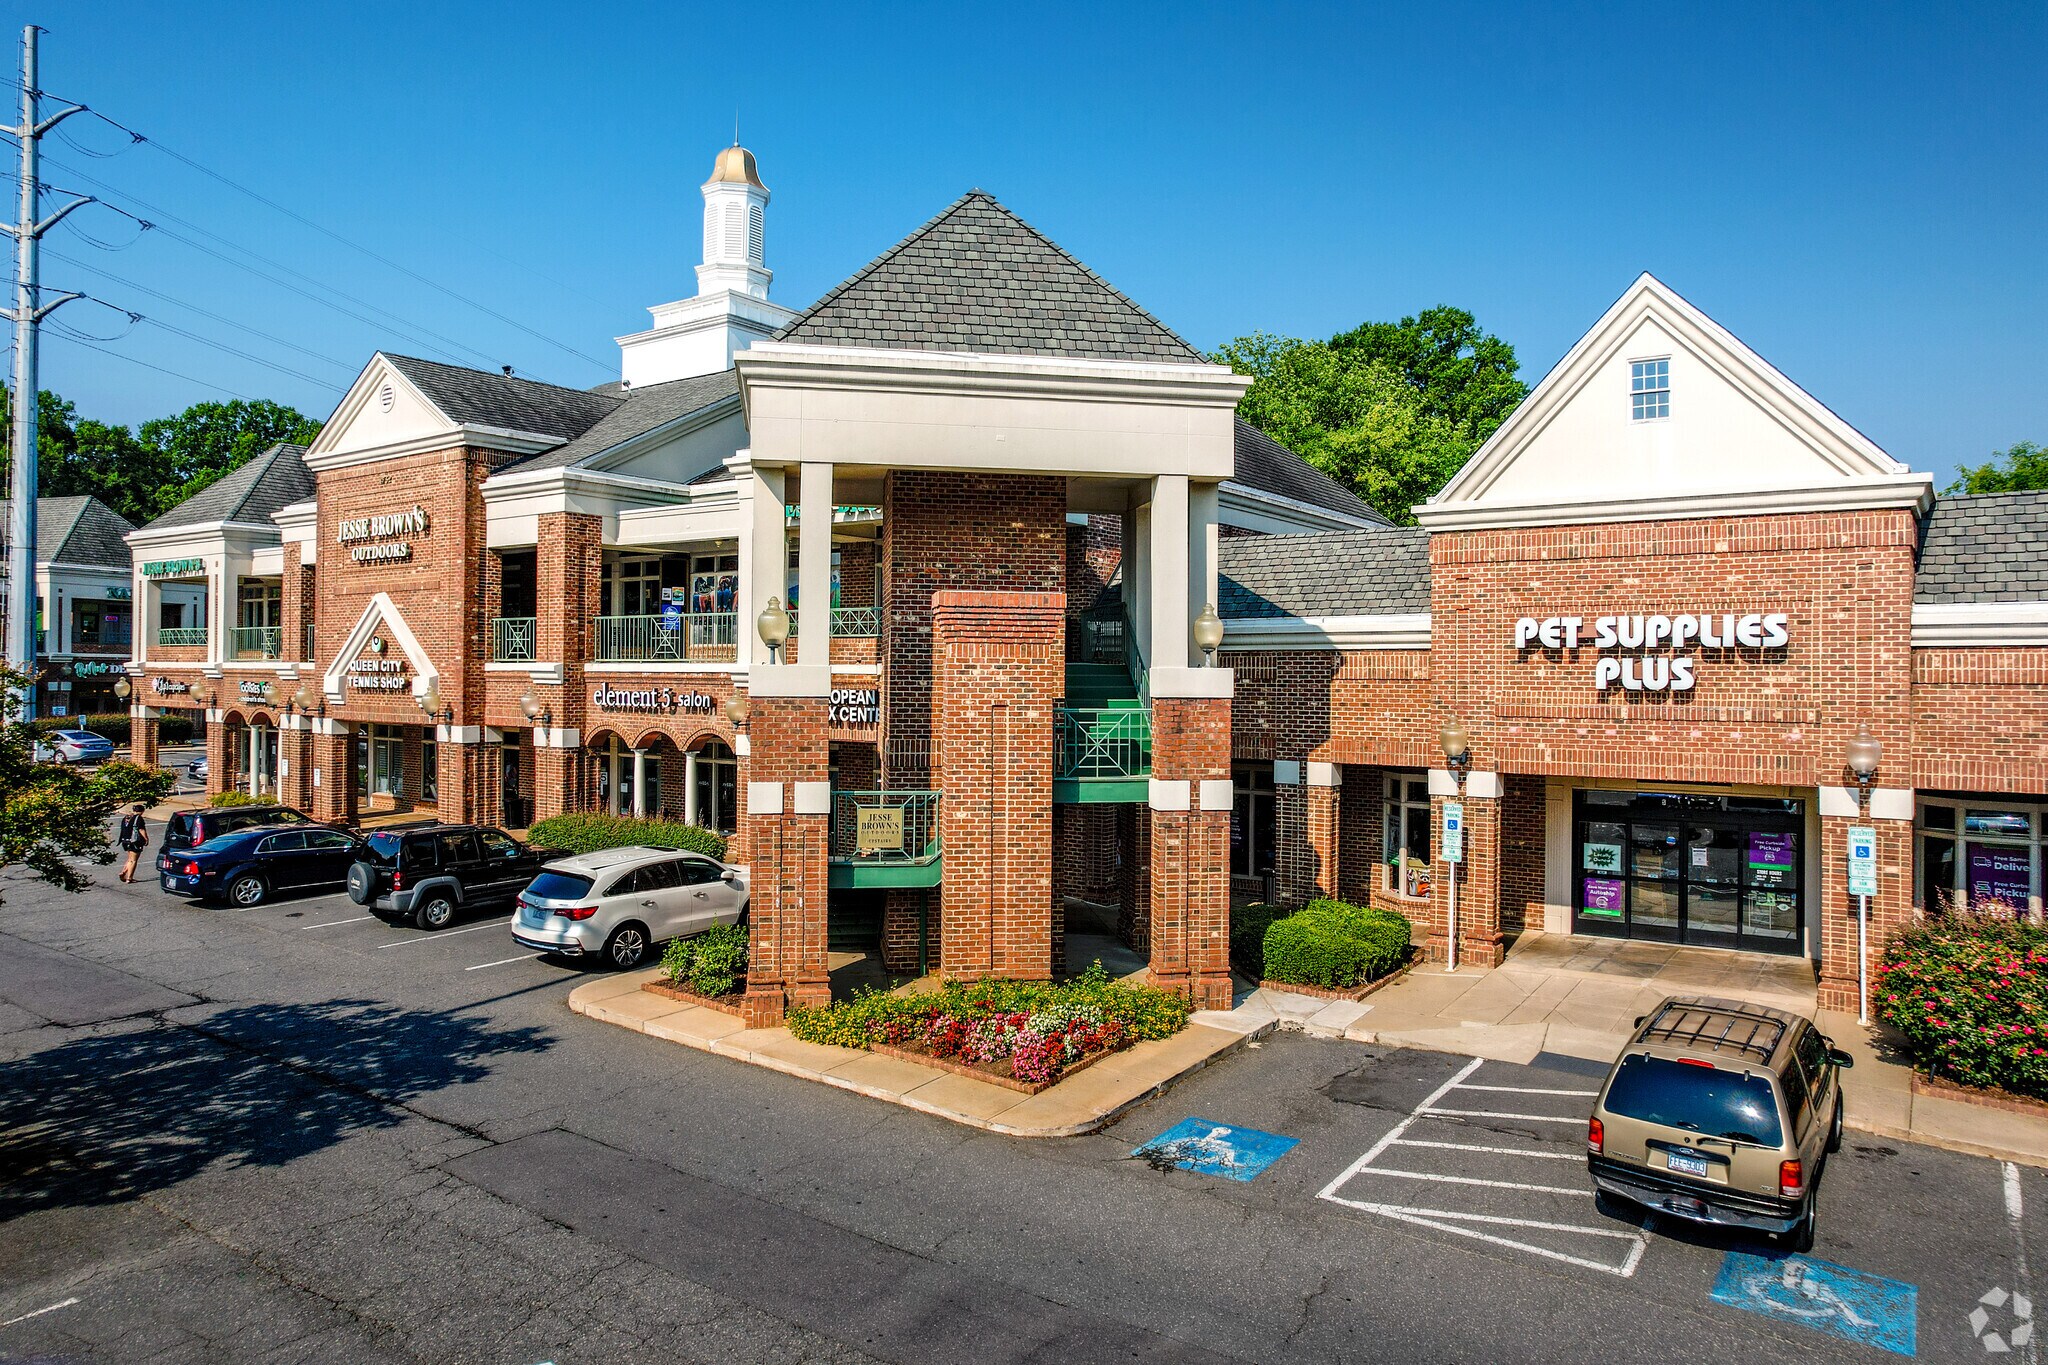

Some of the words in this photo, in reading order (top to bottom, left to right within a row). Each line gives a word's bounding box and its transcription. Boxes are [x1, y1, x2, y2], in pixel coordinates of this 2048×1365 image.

[337, 519, 369, 543] JESSE
[371, 505, 425, 536] BROWN'S
[352, 543, 407, 561] OUTDOORS
[1515, 617, 1583, 649] PET
[1595, 613, 1789, 649] SUPPLIES
[349, 660, 379, 672] QUEEN
[381, 660, 401, 672] CITY
[1595, 657, 1696, 691] PLUS
[347, 676, 379, 688] TENNIS
[381, 677, 405, 689] SHOP
[593, 682, 659, 707] element
[661, 688, 671, 707] 5
[678, 690, 710, 707] salon
[829, 689, 876, 705] OPEAN
[840, 707, 880, 722] CENTE
[861, 822, 900, 830] BROWN'S
[1994, 862, 2030, 872] Delive
[1590, 889, 1616, 897] Autoship
[1994, 888, 2029, 898] Picku
